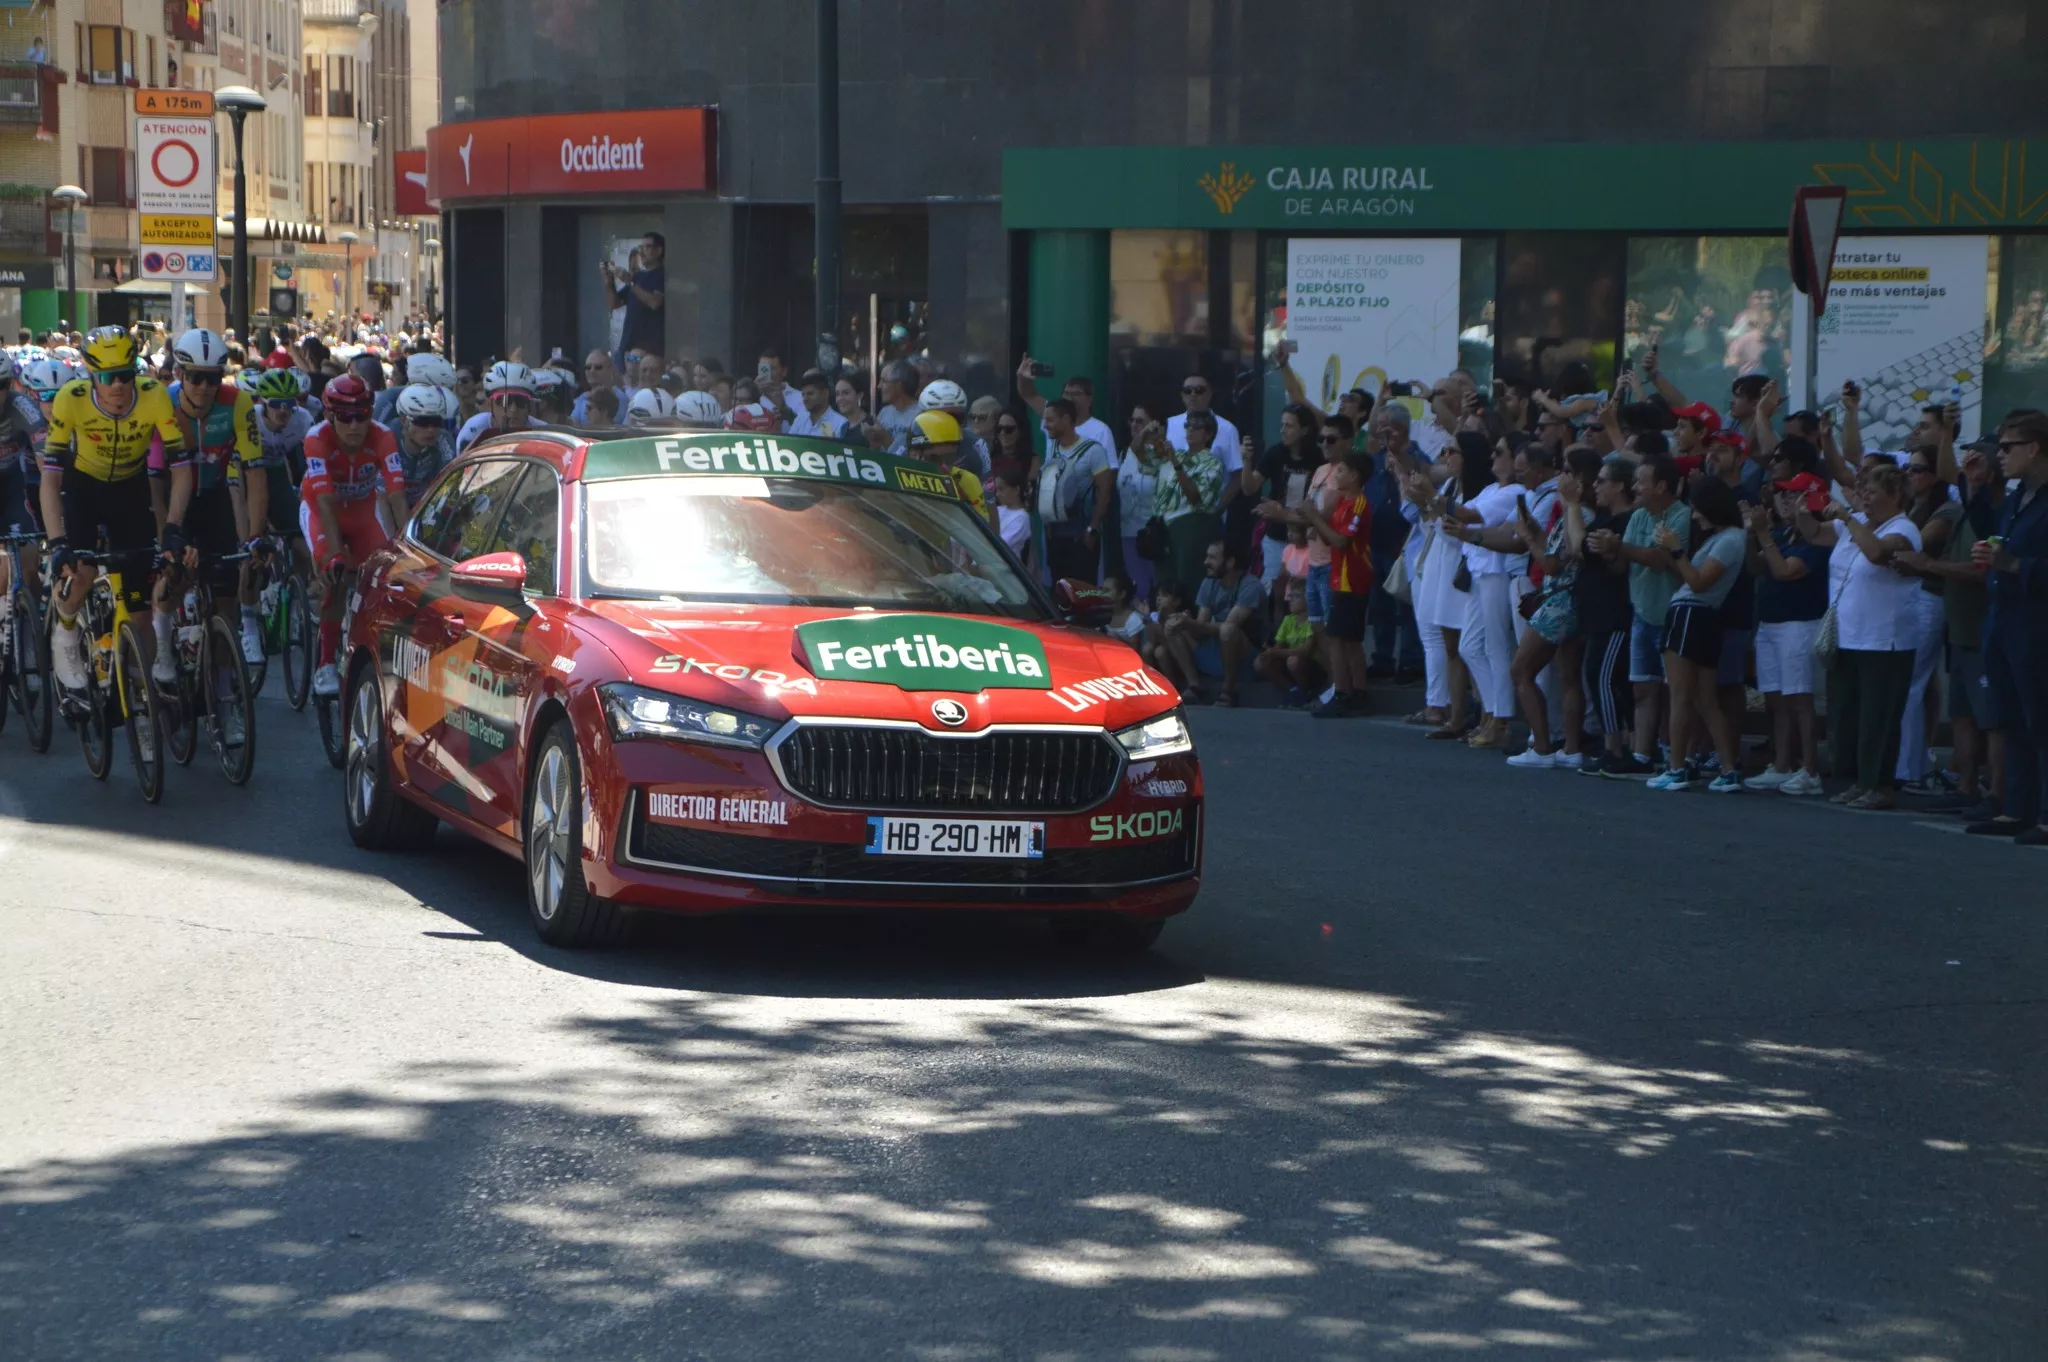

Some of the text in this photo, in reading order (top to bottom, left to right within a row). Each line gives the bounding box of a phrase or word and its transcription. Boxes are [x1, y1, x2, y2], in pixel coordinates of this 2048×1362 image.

[147, 96, 202, 109] A 175m
[560, 135, 645, 173] Occident
[1267, 167, 1433, 190] CAJA RURAL
[1285, 194, 1414, 215] DE ARAGÓN
[153, 219, 200, 228] EXCEPTO
[142, 229, 212, 239] AUTORIZADOS
[169, 258, 181, 267] 20
[1296, 253, 1425, 266] EXPRIME TU DINERO
[1886, 252, 1902, 263] tu
[0, 271, 25, 282] ANA
[1296, 267, 1388, 280] CON NUESTRO
[1880, 267, 1927, 280] online
[1296, 280, 1365, 294] DEPÓSITO
[1828, 284, 1947, 300] ne más ventajas
[1296, 297, 1390, 308] A PLAZO FIJO
[654, 438, 947, 494] Fertiberia META
[816, 634, 1043, 678] Fertiberia
[1147, 779, 1187, 795] HYBRID
[649, 792, 789, 825] DIRECTOR GENERAL
